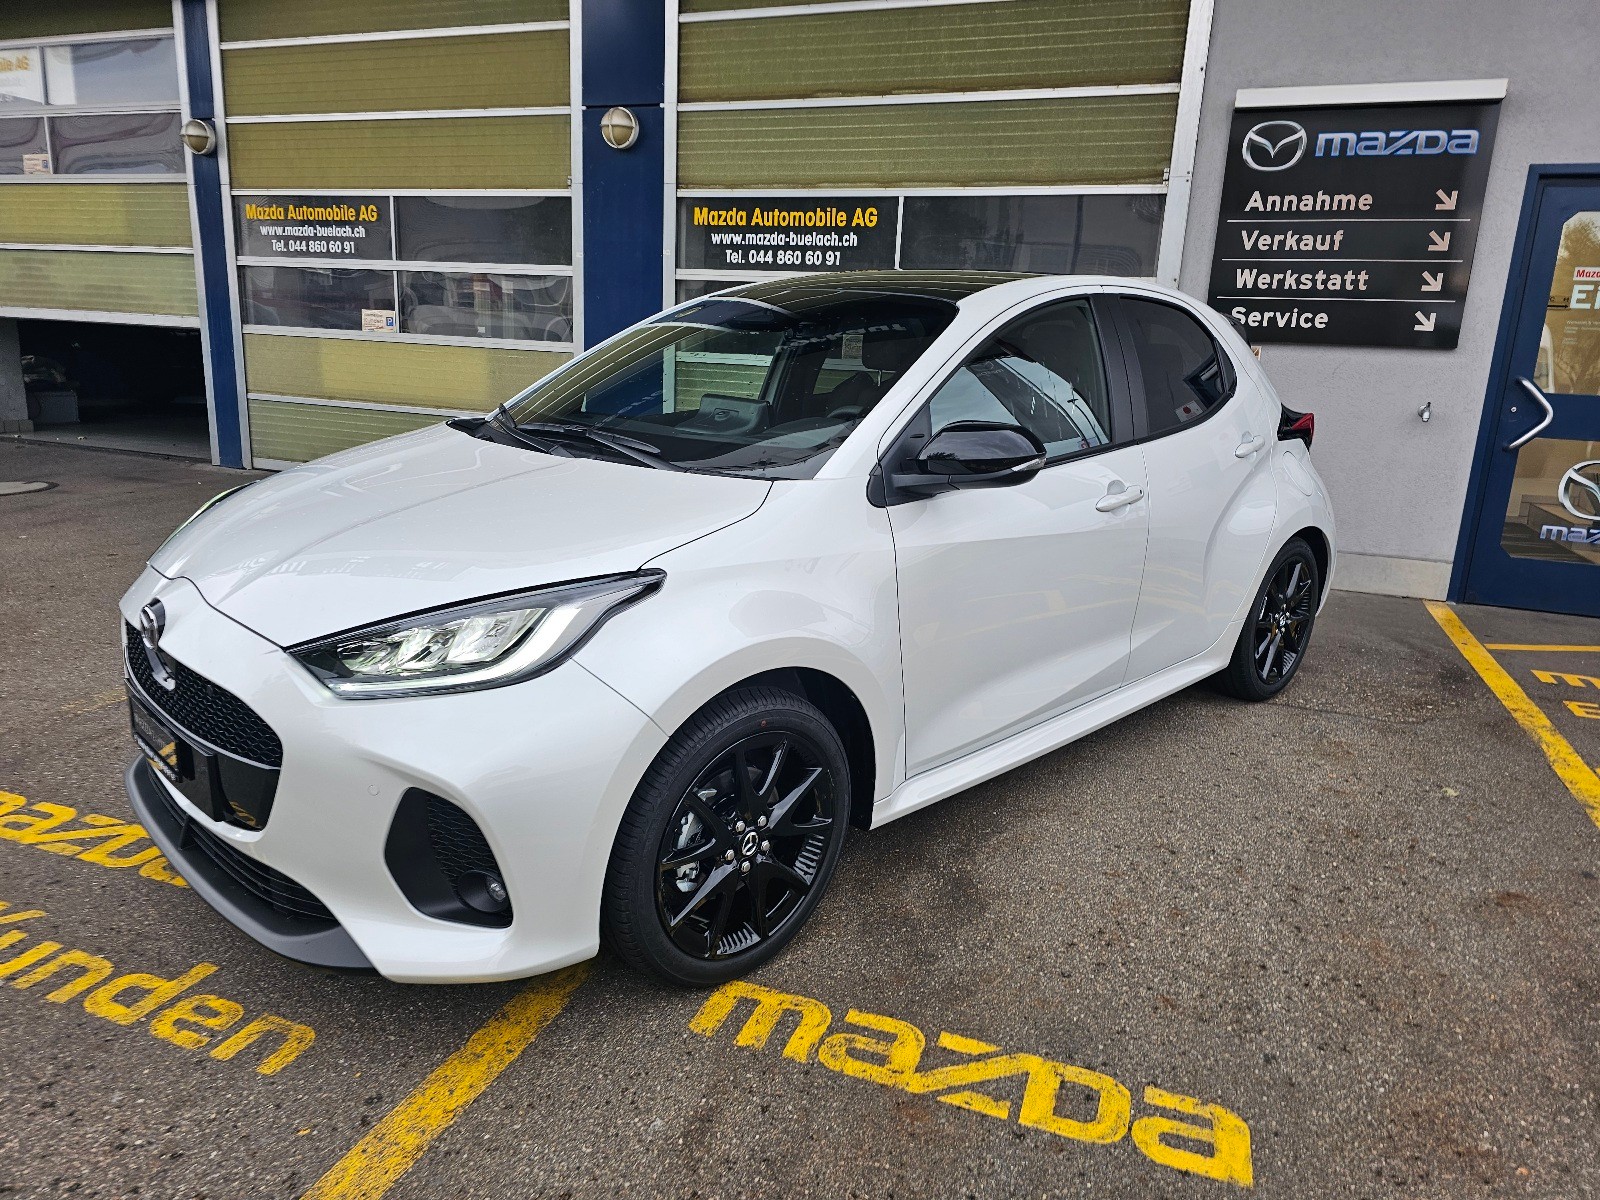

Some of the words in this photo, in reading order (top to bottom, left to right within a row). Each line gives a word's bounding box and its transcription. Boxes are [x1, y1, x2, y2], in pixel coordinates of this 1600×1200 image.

[1244, 190, 1373, 212] Annahme
[245, 204, 285, 220] Mazda
[287, 204, 356, 221] Automobile
[358, 204, 378, 222] AG
[693, 207, 747, 226] Mazda
[750, 207, 847, 227] Automobile
[851, 207, 878, 227] AG
[260, 225, 366, 238] www.mazda-buelach.ch
[711, 232, 858, 247] www.mazda-buelach.ch
[1241, 229, 1344, 251] Verkauf
[271, 239, 287, 252] Tel.
[288, 240, 307, 252] 044
[308, 241, 327, 253] 860
[328, 241, 342, 253] 60
[343, 241, 355, 254] 91
[725, 249, 746, 264] Tel.
[748, 250, 774, 264] 044
[776, 251, 802, 265] 860
[804, 251, 823, 266] 60
[825, 250, 841, 266] 91
[1236, 269, 1369, 291] Werkstatt
[1231, 306, 1329, 329] Service
